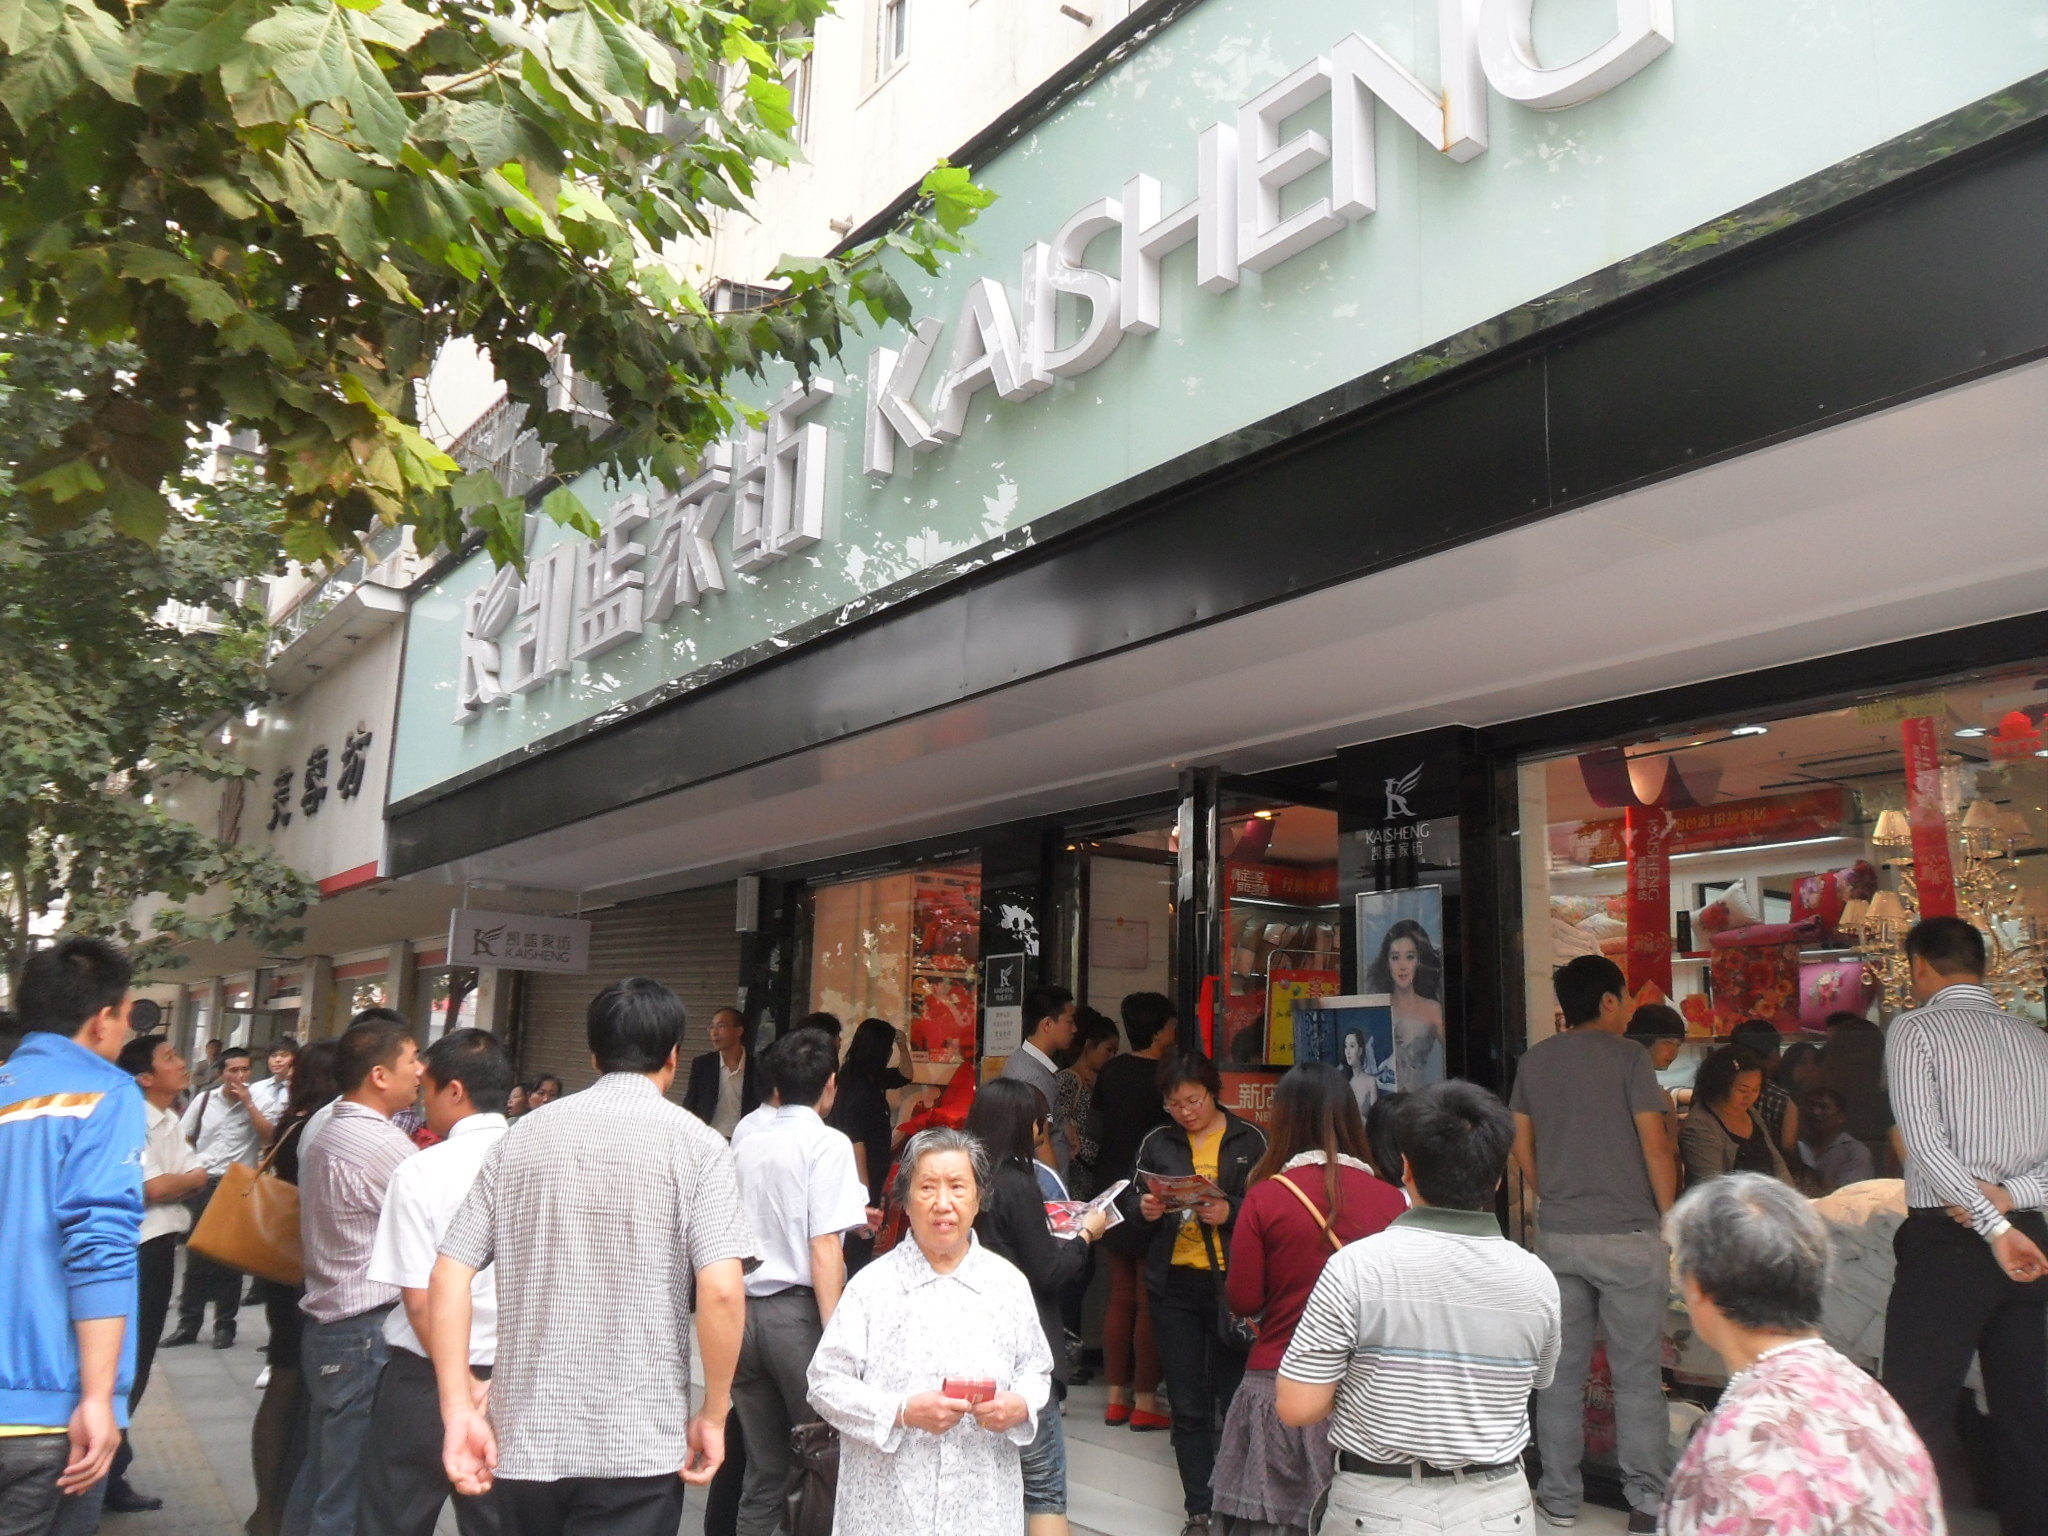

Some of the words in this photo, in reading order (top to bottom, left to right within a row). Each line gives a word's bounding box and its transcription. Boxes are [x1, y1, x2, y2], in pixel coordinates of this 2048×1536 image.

[1365, 823, 1430, 844] KAISHENG
[1647, 819, 1661, 901] KAISHENG
[505, 947, 570, 963] KAISHENG
